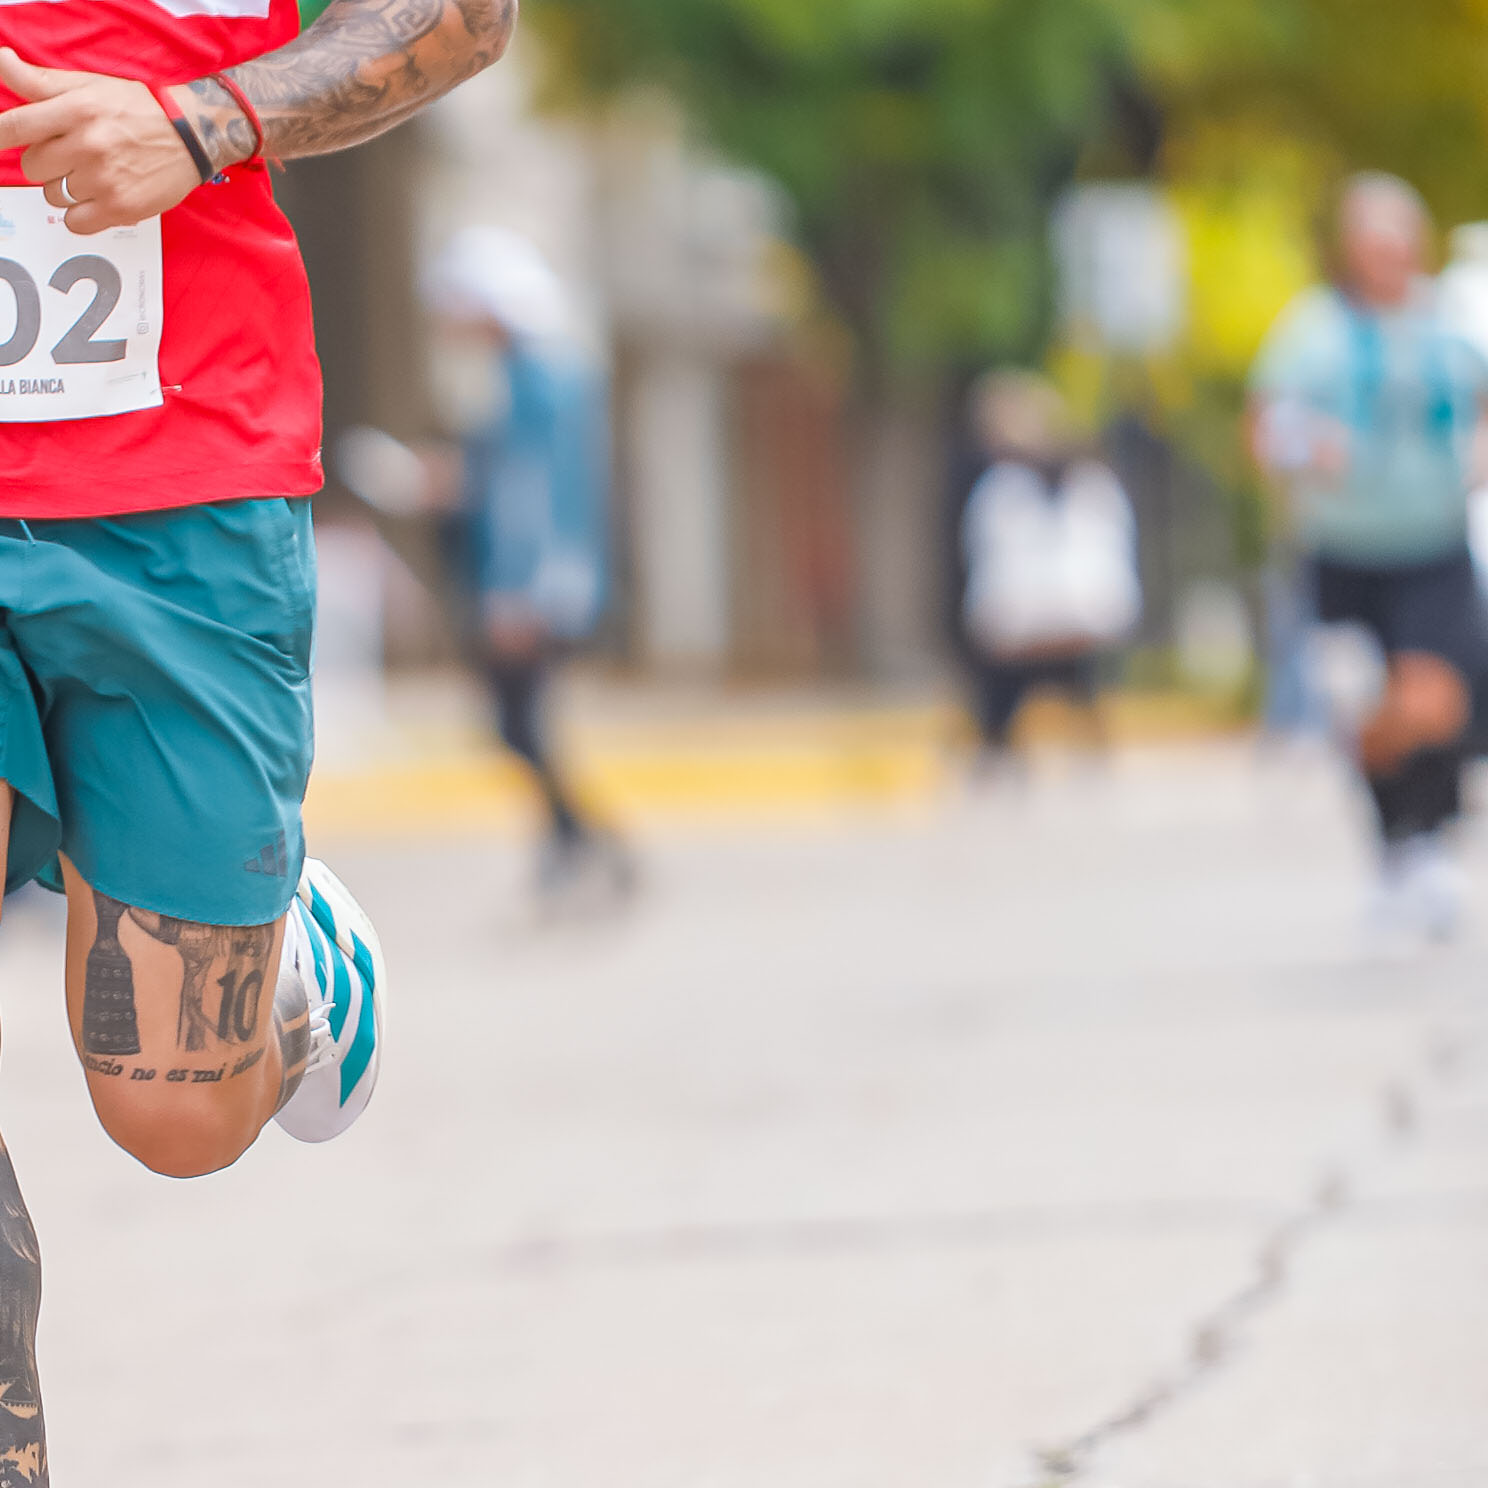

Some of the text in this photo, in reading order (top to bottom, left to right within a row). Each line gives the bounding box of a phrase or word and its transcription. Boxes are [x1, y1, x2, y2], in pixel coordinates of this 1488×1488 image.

[19, 378, 65, 395] BIANCA
[216, 968, 264, 1044] 10
[130, 1067, 157, 1081] no
[165, 1068, 190, 1083] es
[191, 1062, 227, 1083] mi
